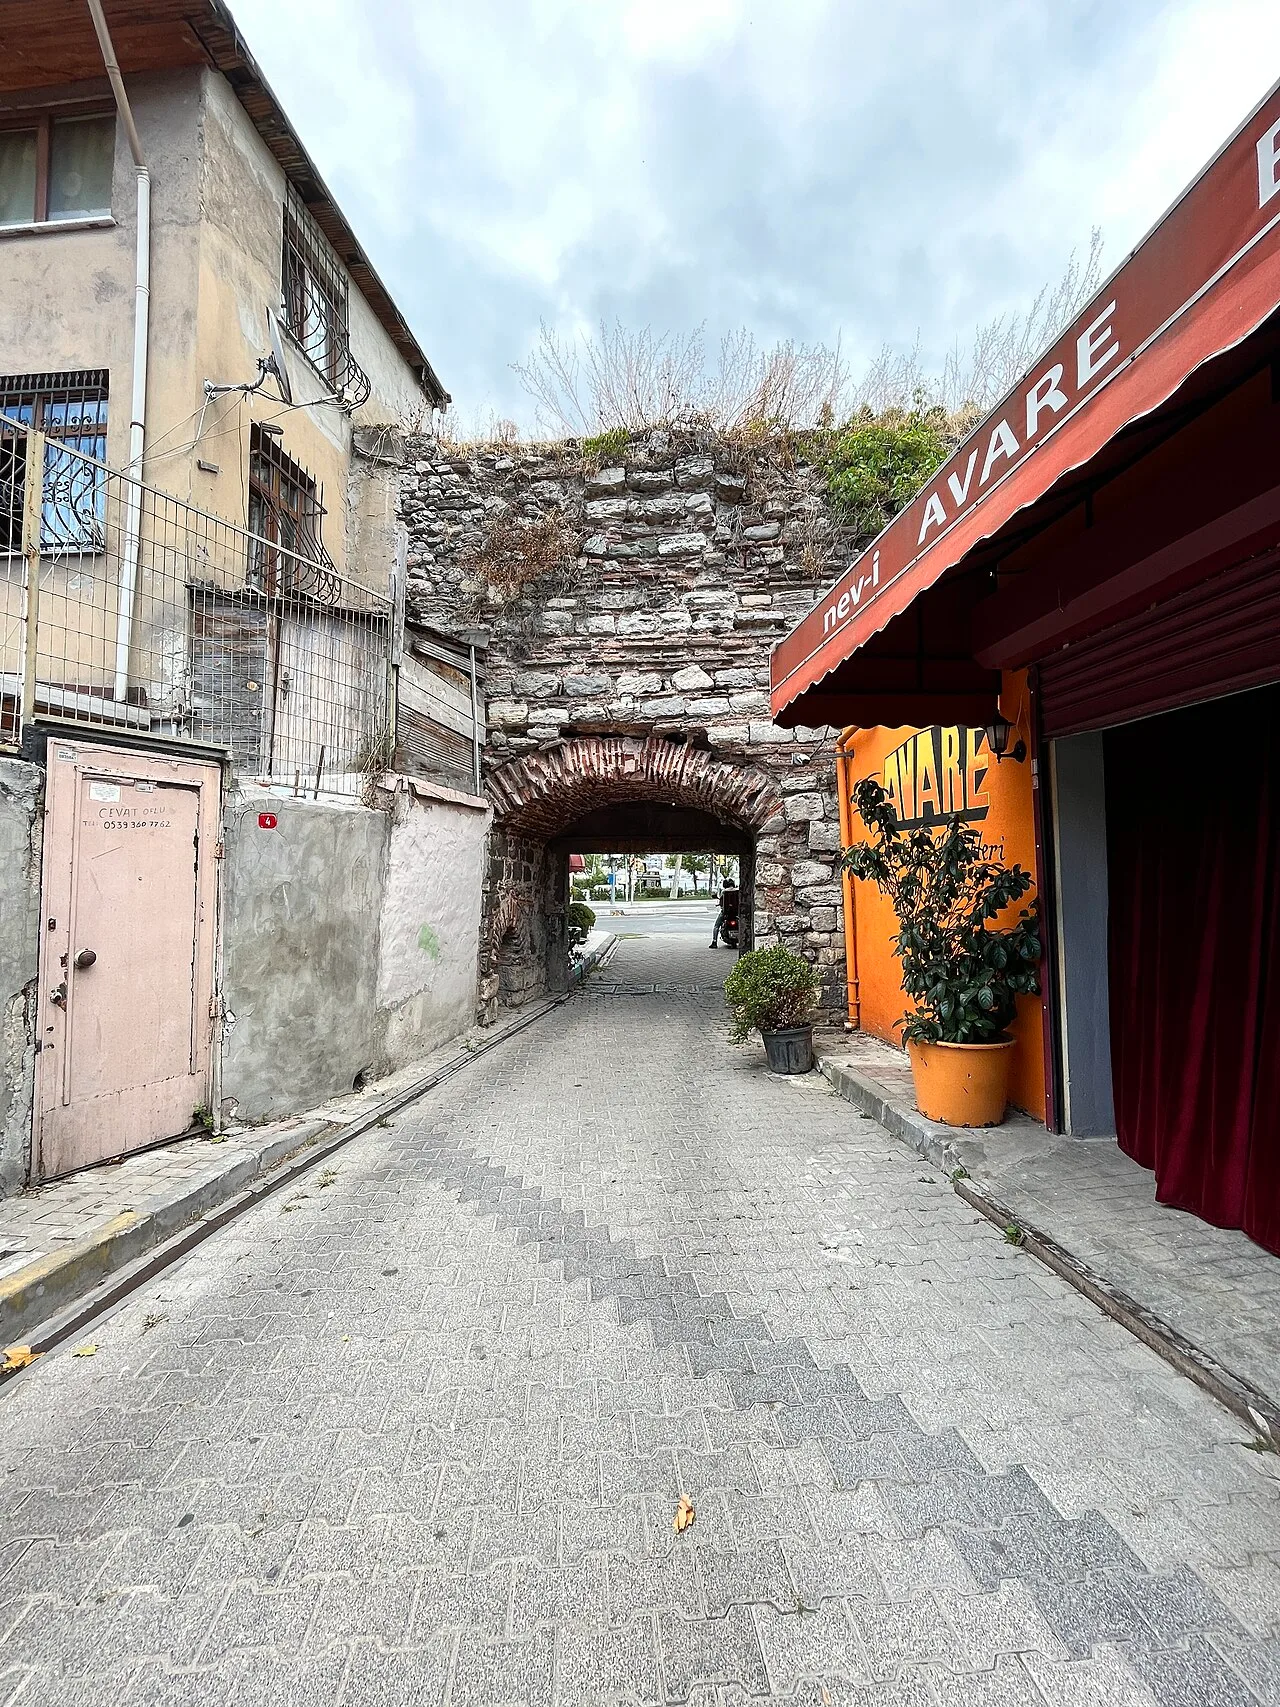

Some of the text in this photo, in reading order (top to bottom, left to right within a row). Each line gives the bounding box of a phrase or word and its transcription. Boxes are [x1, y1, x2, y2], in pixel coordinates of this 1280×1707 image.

[823, 299, 1120, 634] nev-i AVARE
[884, 725, 990, 822] AVARE
[98, 807, 138, 819] CEVAT
[103, 820, 128, 830] 0539
[149, 820, 171, 828] 7762
[265, 816, 271, 826] 4
